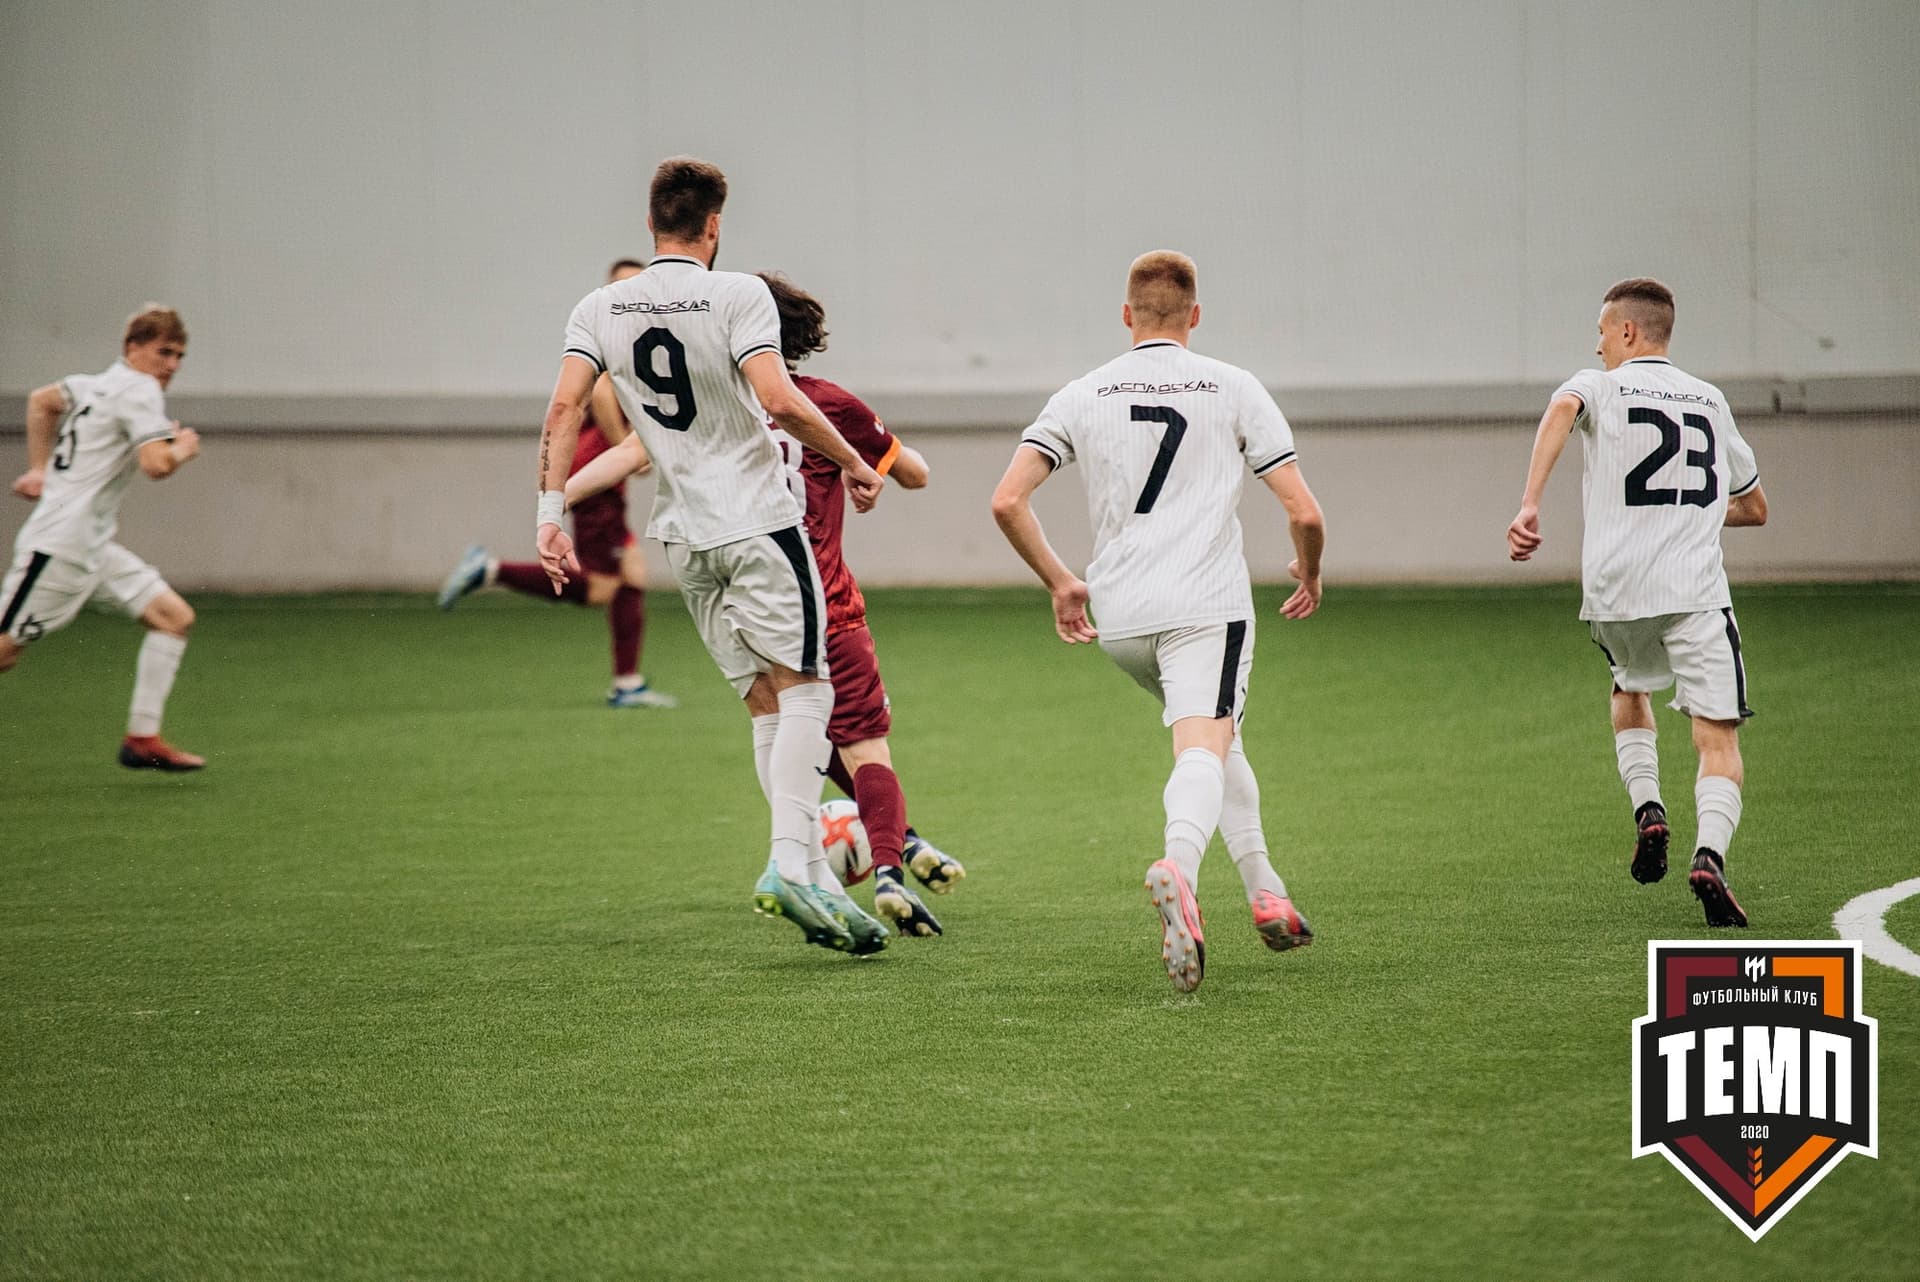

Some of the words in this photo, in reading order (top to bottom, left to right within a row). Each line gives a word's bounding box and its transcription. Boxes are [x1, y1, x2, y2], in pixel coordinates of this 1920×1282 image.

[632, 326, 697, 432] 9
[1130, 405, 1188, 513] 7
[1624, 407, 1719, 508] 23
